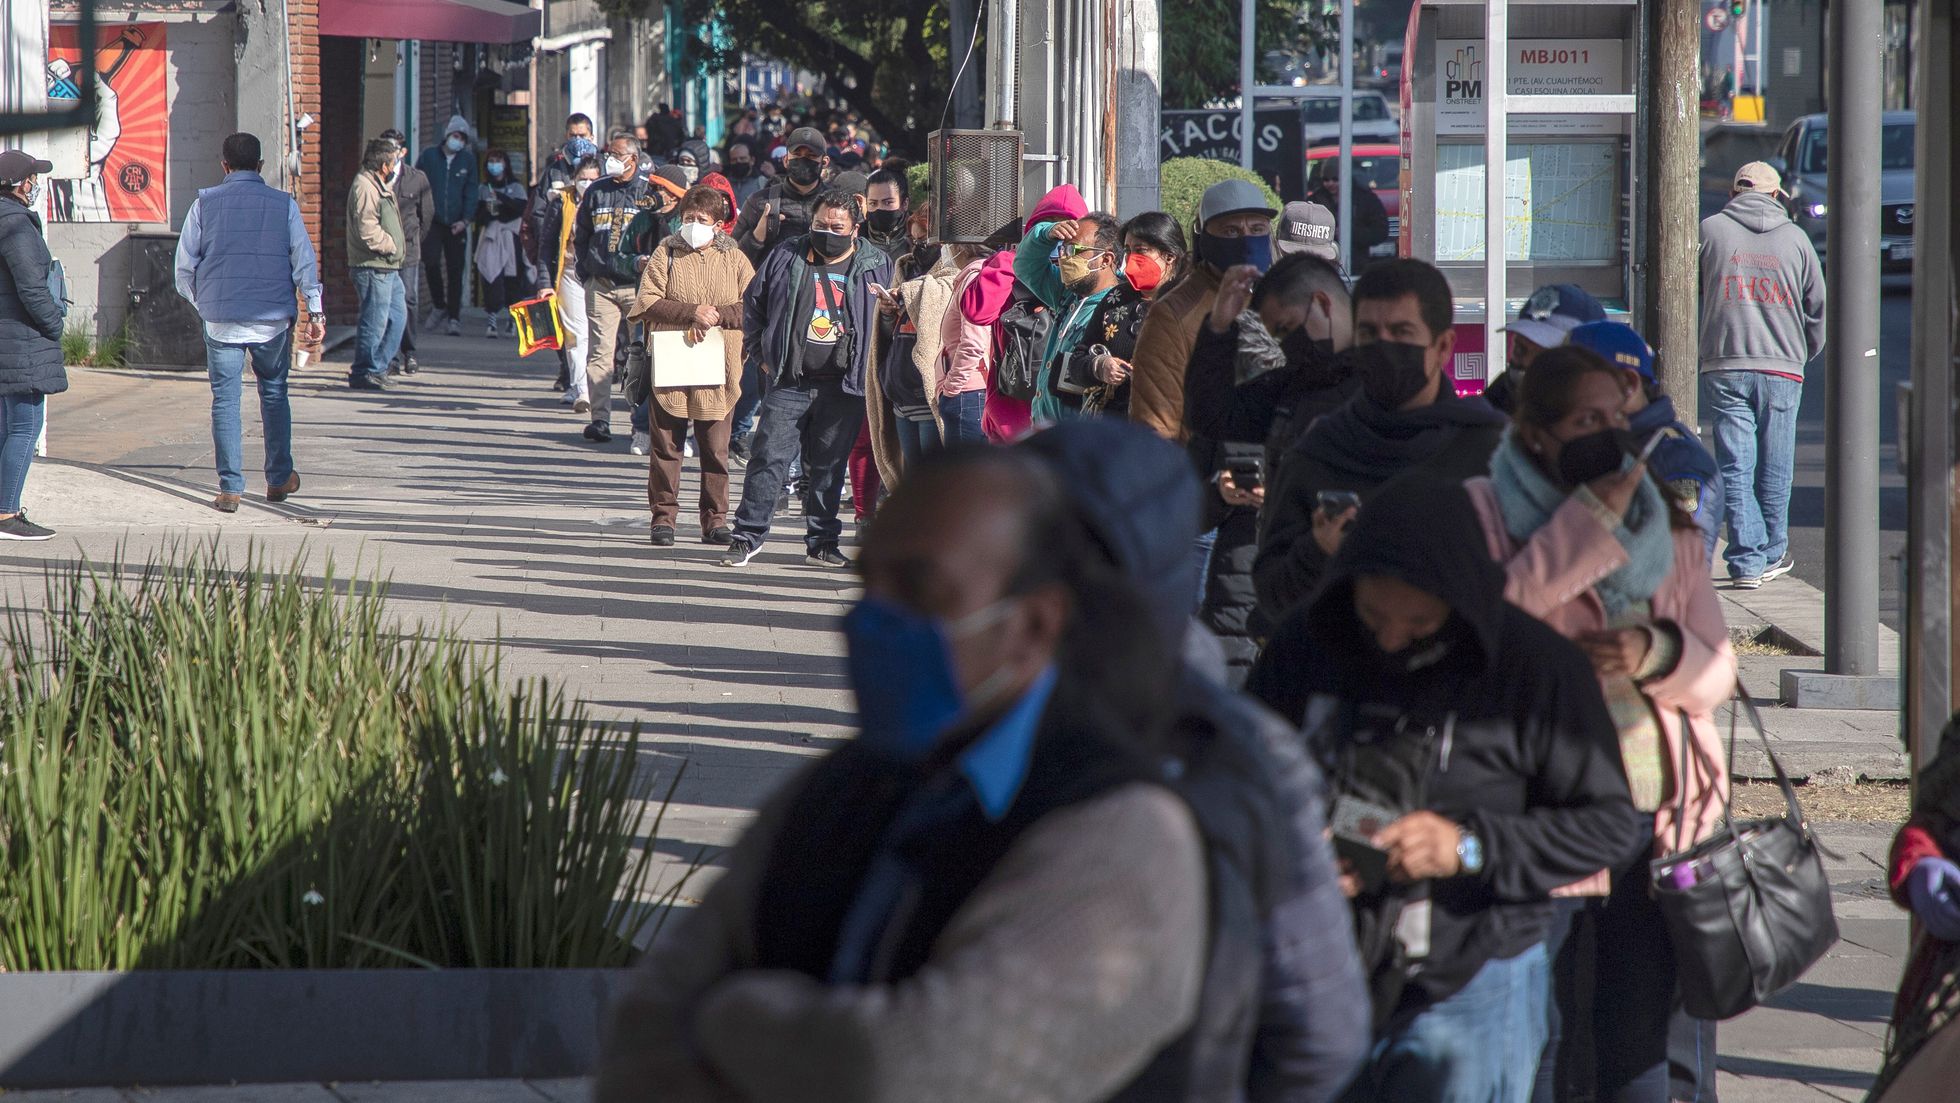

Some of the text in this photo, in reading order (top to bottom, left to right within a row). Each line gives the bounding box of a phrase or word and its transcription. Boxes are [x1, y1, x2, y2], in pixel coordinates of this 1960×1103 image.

[1520, 50, 1590, 64] MBJ011
[1446, 80, 1482, 98] PM
[1534, 87, 1568, 95] ESQUINA
